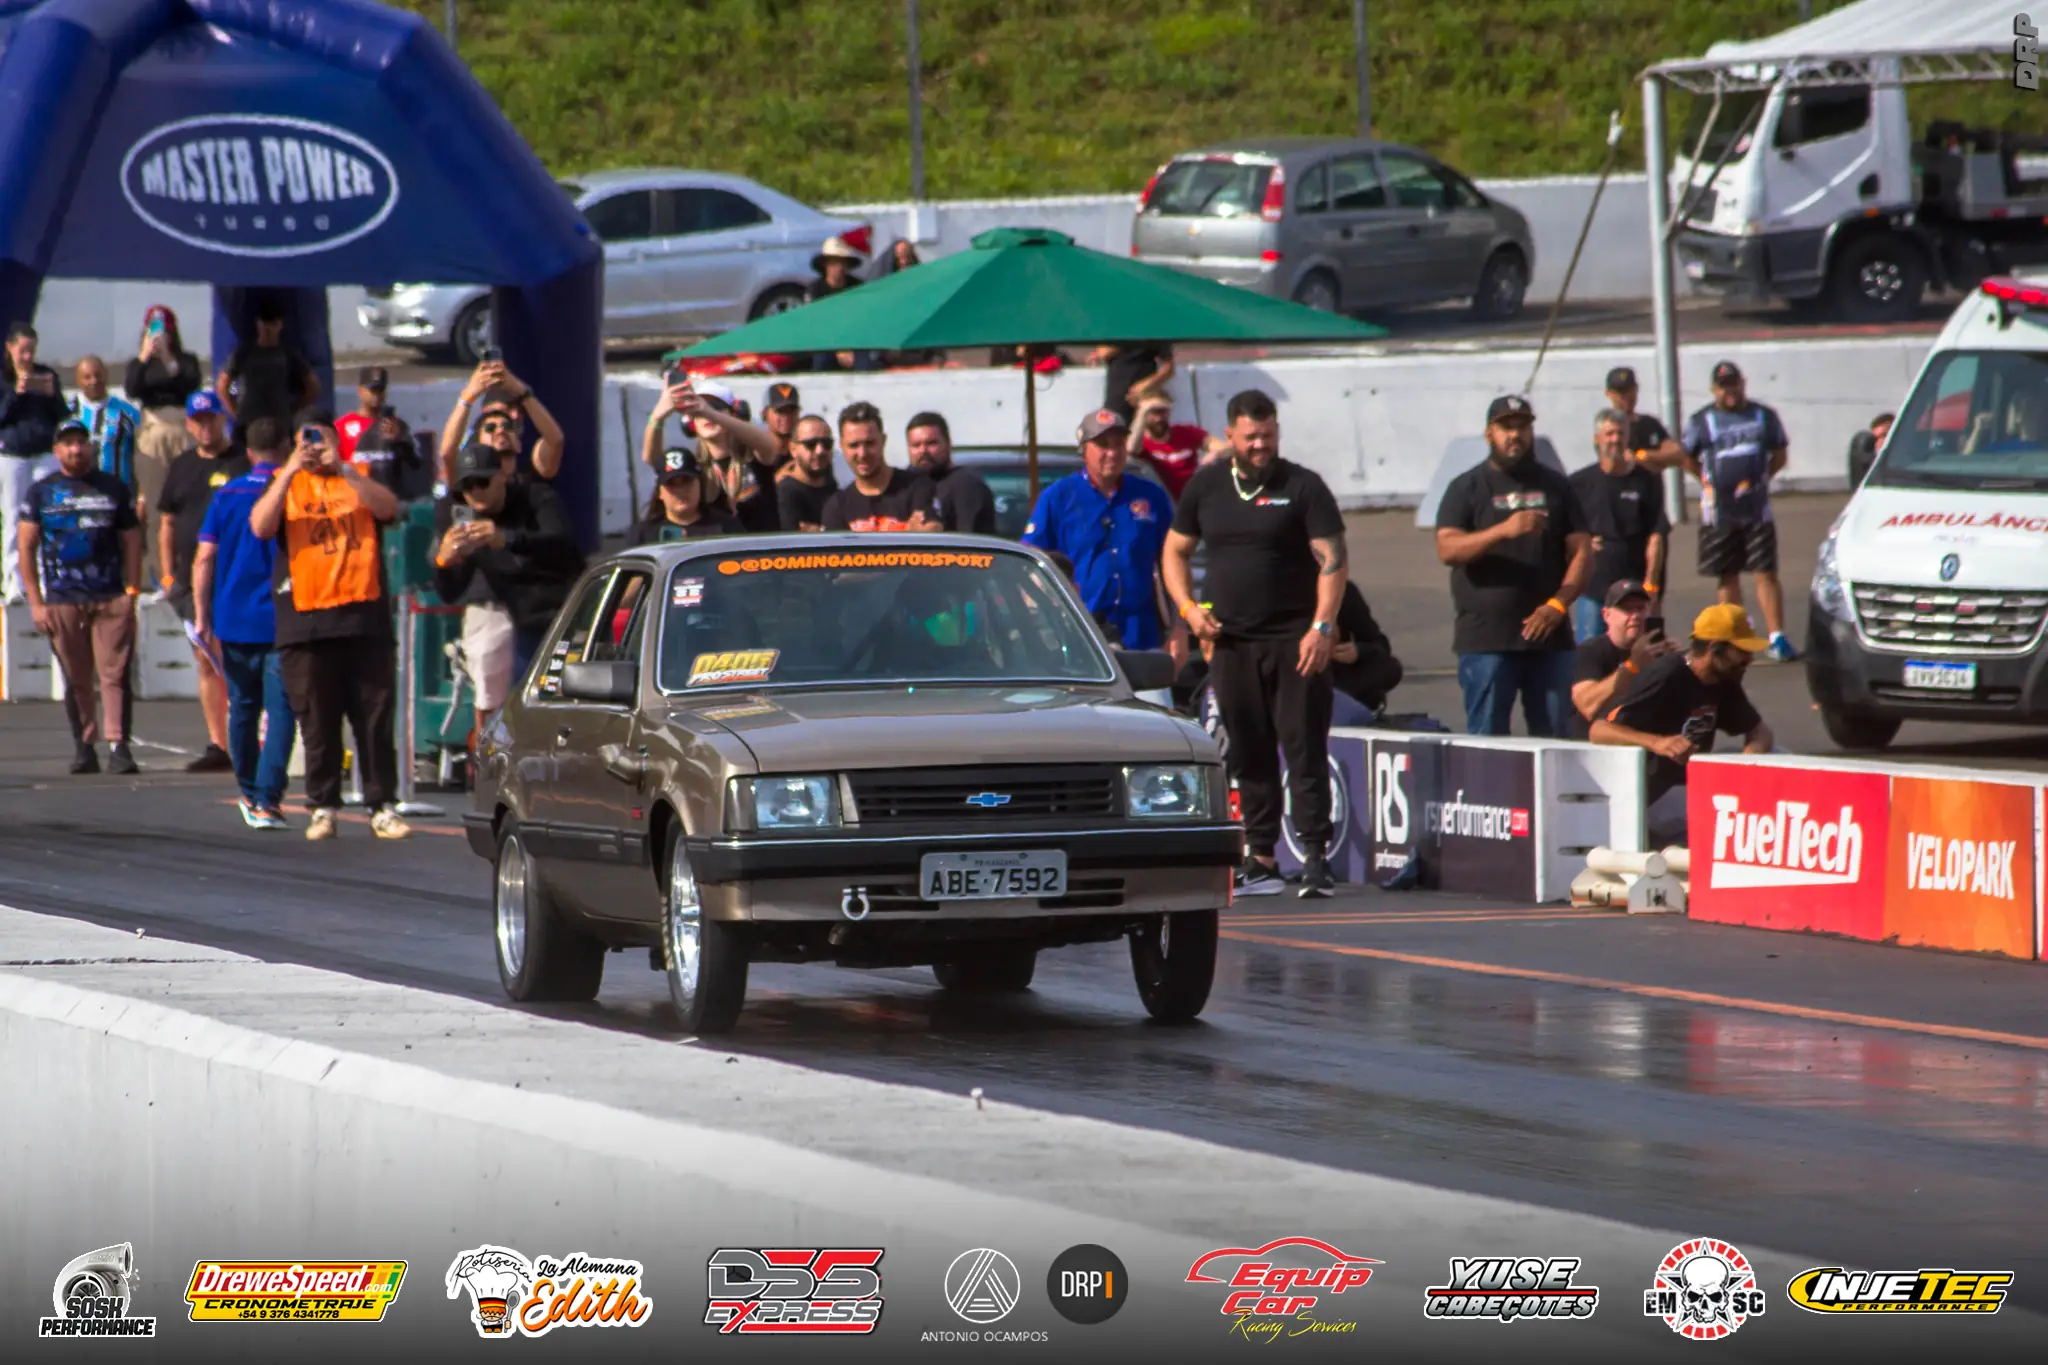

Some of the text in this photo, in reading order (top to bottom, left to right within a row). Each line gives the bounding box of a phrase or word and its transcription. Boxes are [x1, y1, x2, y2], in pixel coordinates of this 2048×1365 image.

[141, 136, 375, 205] MASTER POWER
[1375, 752, 1410, 844] RS
[1712, 795, 1863, 884] FuelTech
[1908, 832, 2016, 900] VELOPARK
